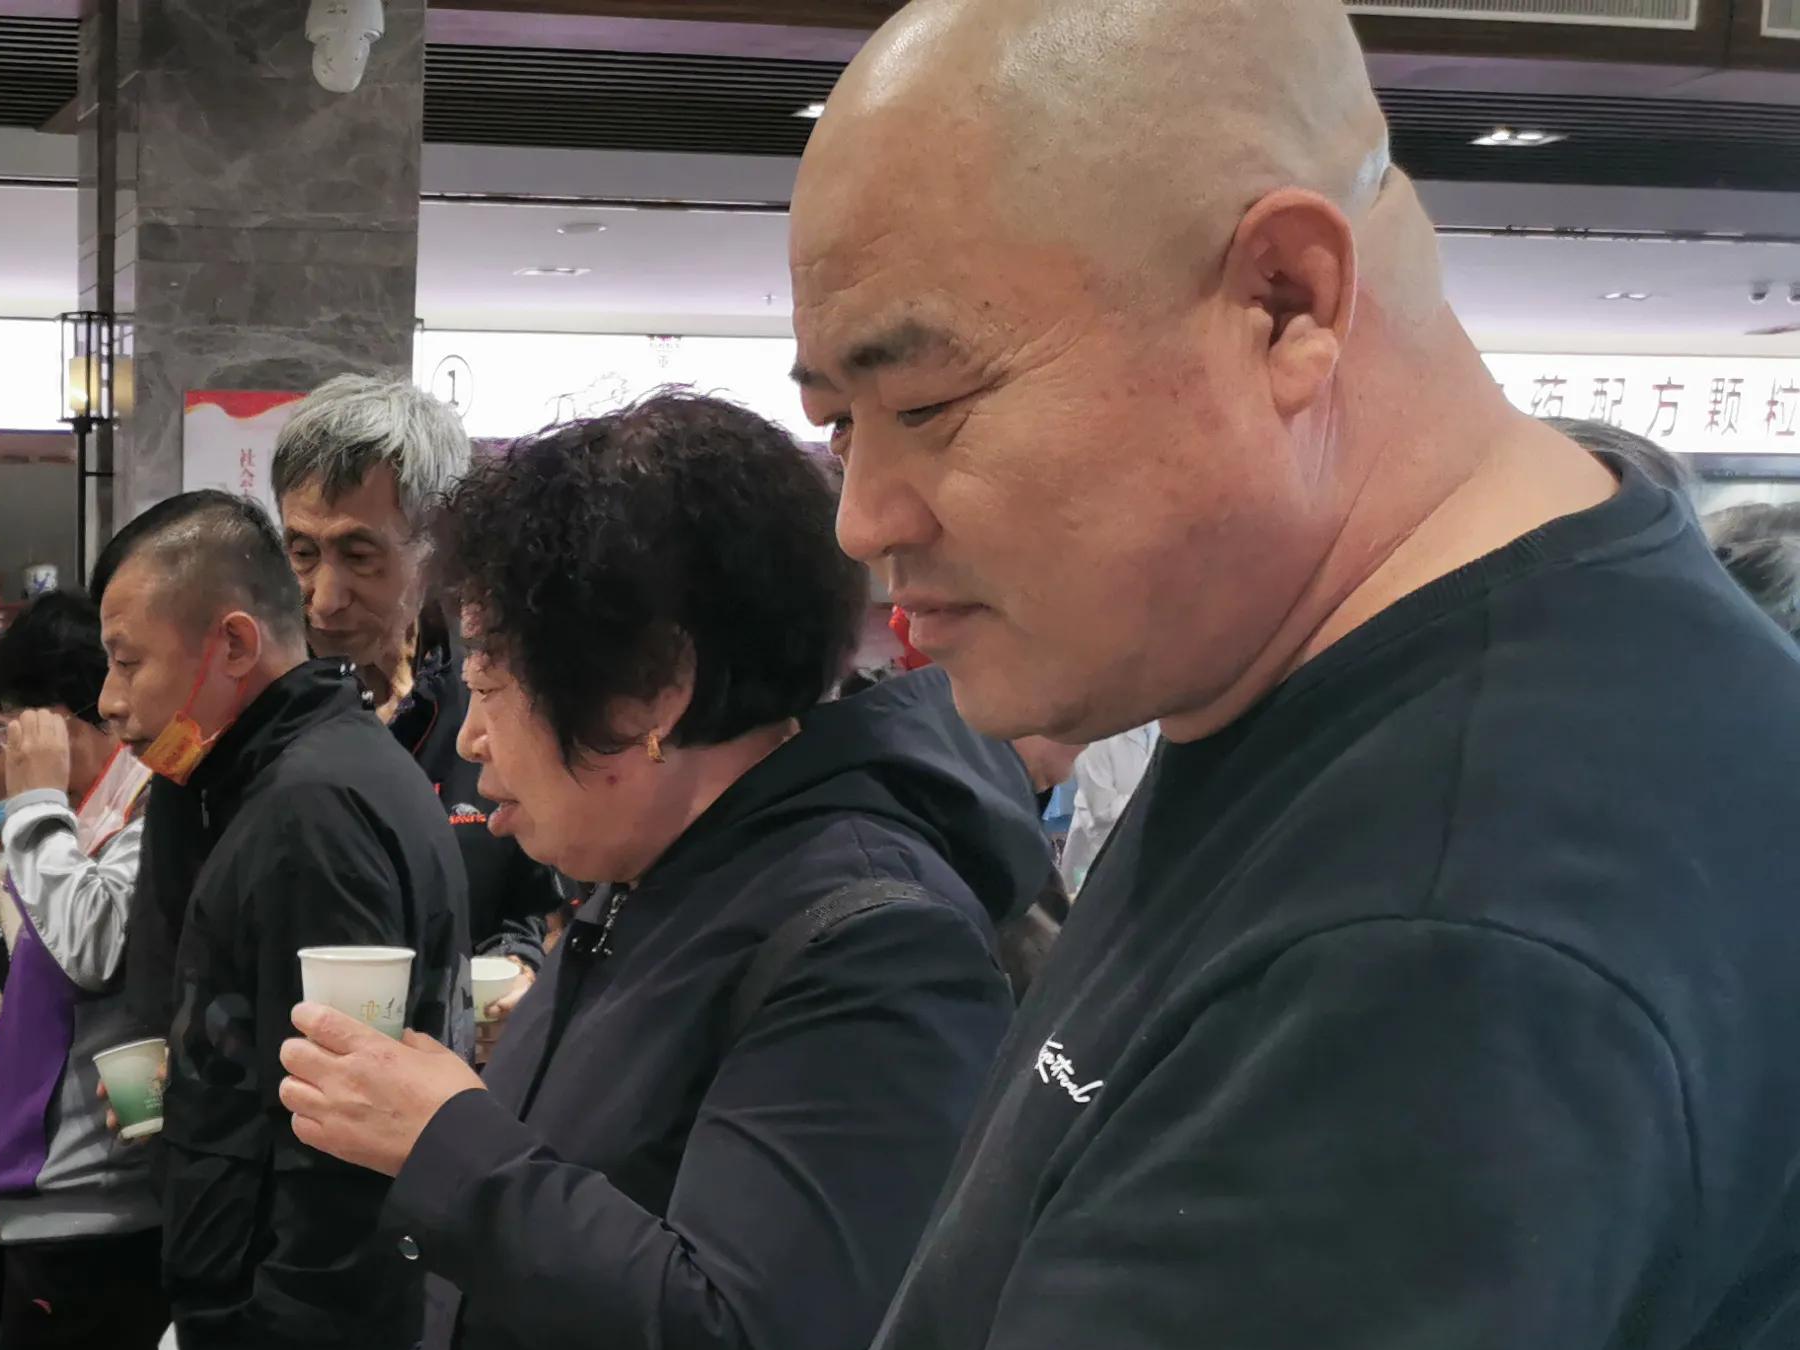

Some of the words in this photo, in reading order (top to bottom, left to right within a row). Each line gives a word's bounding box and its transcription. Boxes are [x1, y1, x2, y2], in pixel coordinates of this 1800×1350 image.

[1498, 375, 1800, 438] 药配方颗粒
